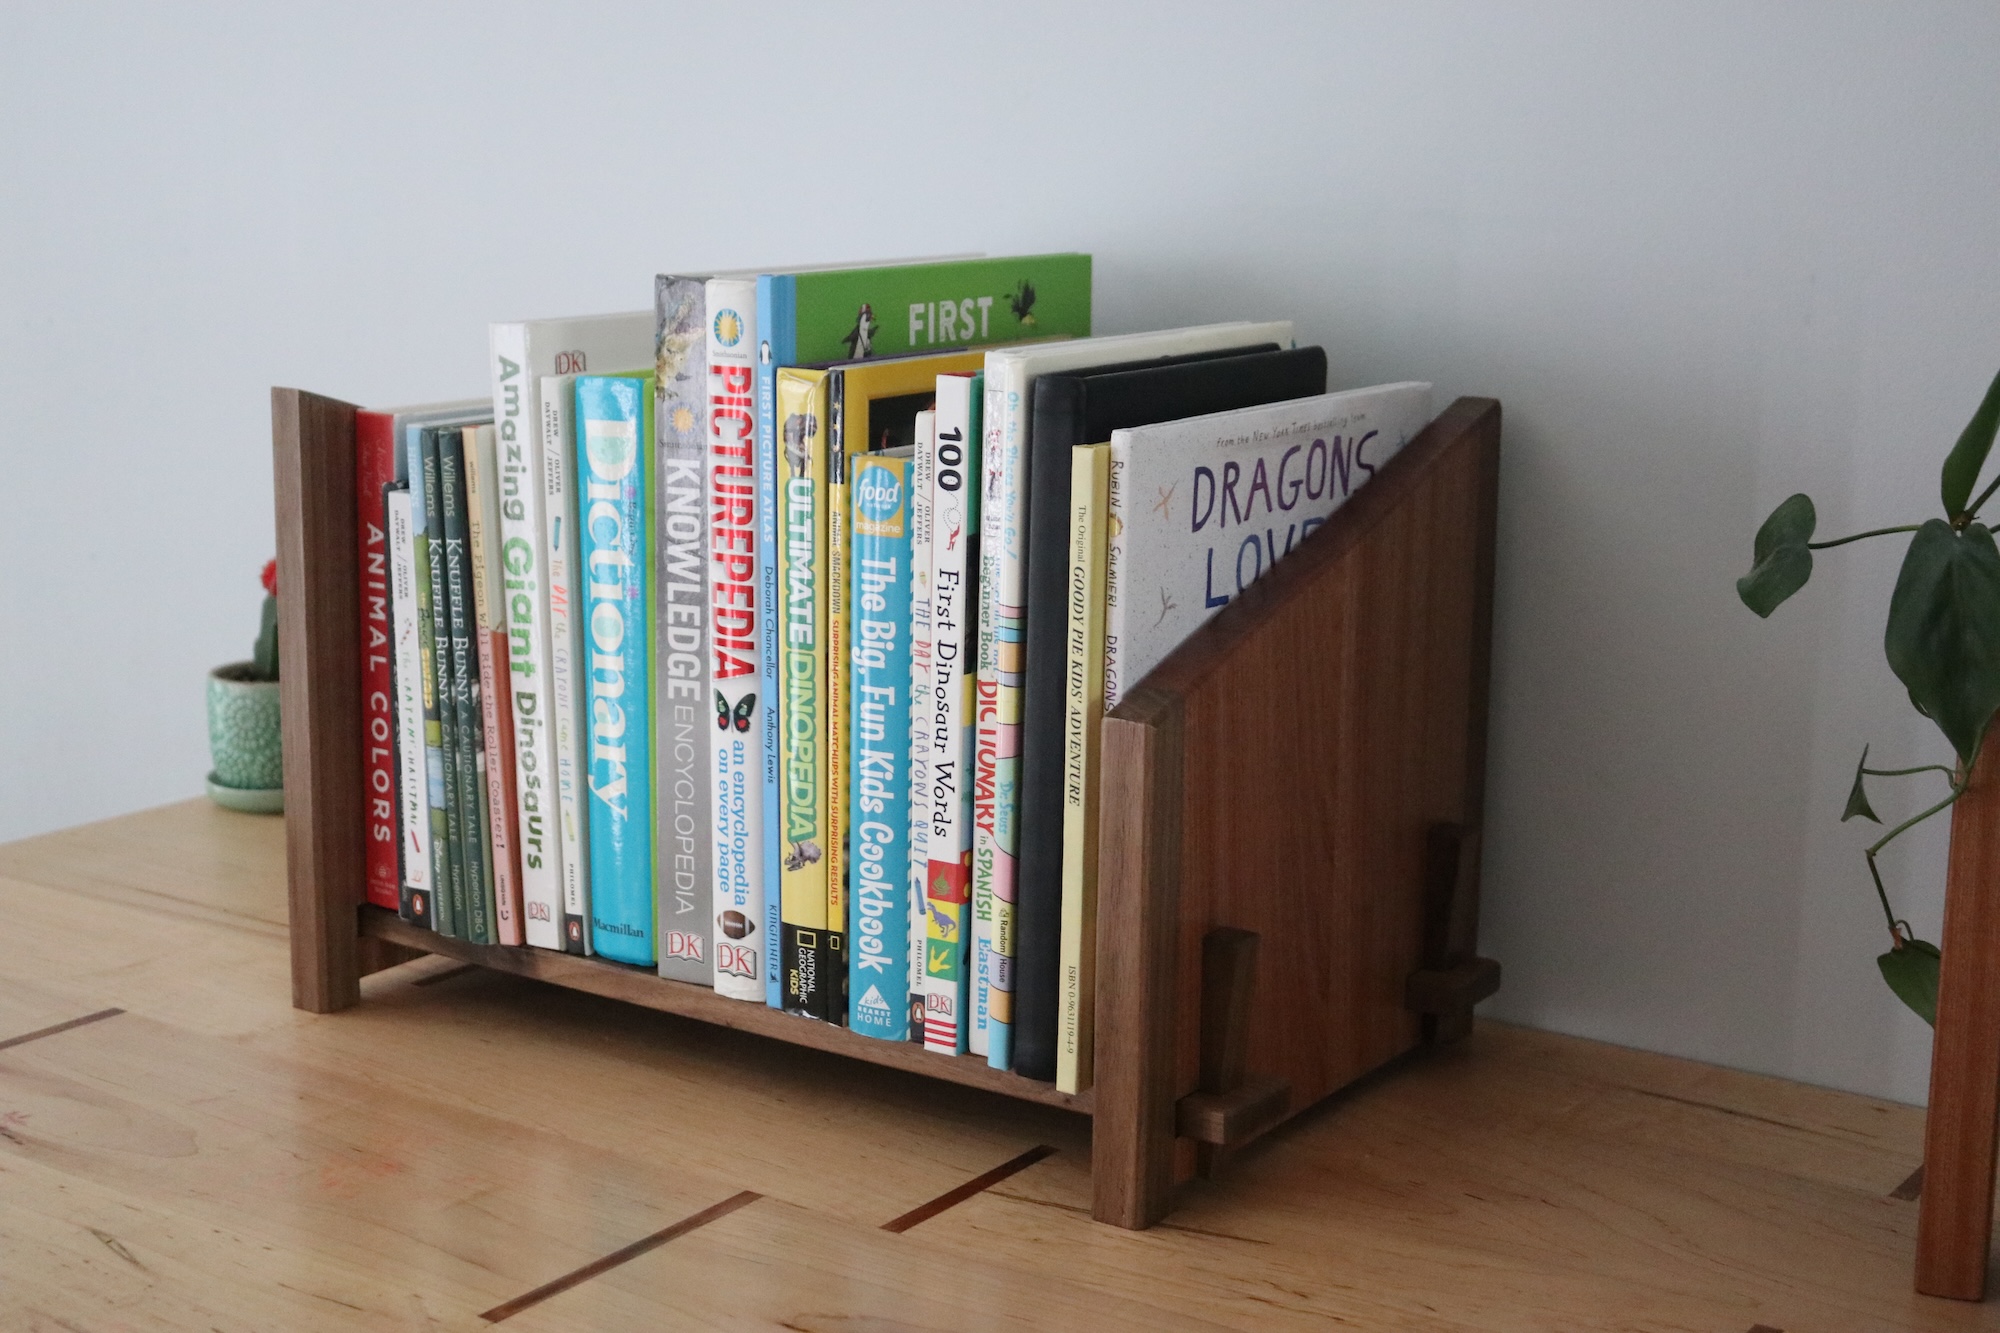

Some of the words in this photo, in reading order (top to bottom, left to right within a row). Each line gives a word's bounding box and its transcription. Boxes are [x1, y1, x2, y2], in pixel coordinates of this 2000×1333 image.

[909, 296, 993, 346] FIRST
[557, 352, 582, 375] DK
[712, 350, 748, 359] Smithsonian
[762, 376, 771, 420] FIRST
[498, 355, 527, 521] Amazing
[1007, 421, 1018, 442] the
[1216, 436, 1235, 448] from
[1236, 434, 1249, 445] the
[1312, 416, 1348, 431] bestselling
[762, 425, 772, 491] PICTURE
[937, 426, 963, 492] 100
[1005, 445, 1019, 486] Places
[1191, 429, 1379, 533] DRAGONS
[424, 456, 436, 517] Willems
[443, 455, 456, 517] Willems
[858, 477, 901, 508] food
[1004, 490, 1018, 522] You'll
[1110, 460, 1124, 508] RUBIN
[472, 521, 480, 548] The
[710, 364, 755, 682] PICTUREPEDIA
[763, 496, 773, 543] ATLAS
[856, 521, 901, 533] magazine
[1078, 505, 1087, 523] The
[788, 478, 813, 645] ULTIMATE
[1004, 527, 1018, 560] Go!
[1076, 524, 1086, 563] Original
[1205, 516, 1326, 609] LOV
[367, 521, 387, 672] ANIMAL
[428, 538, 444, 628] KNUFFLE
[446, 537, 464, 628] KNUFFLE
[474, 554, 484, 606] Pigeon
[552, 584, 568, 618] DAY
[666, 458, 701, 701] KNOWLEDGE
[764, 566, 774, 615] Deborah
[832, 550, 841, 614] SMACKDOWN
[861, 556, 897, 613] The
[937, 568, 960, 631] First
[979, 555, 994, 628] Beginner
[1073, 566, 1085, 627] GOODY
[503, 536, 536, 678] Giant
[585, 418, 637, 822] Dictionary
[915, 598, 931, 631] THE
[765, 618, 776, 680] Chancellor
[832, 620, 840, 681] SURPRISING
[851, 619, 897, 675] Big,
[914, 640, 932, 674] DAY
[980, 631, 993, 670] Book
[1072, 628, 1084, 657] PIE
[435, 636, 449, 704] BUNNY
[452, 636, 469, 705] BUNNY
[482, 652, 491, 687] Ride
[1070, 659, 1083, 704] KIDS'
[1104, 635, 1117, 712] DRAGONS
[441, 709, 449, 718] A
[460, 711, 469, 720] A
[485, 694, 493, 719] the
[860, 684, 895, 741] Fun
[914, 684, 931, 705] the
[934, 639, 957, 754] Dinosaur
[487, 725, 498, 773] Roller
[732, 740, 745, 766] an
[765, 706, 776, 752] Anthony
[789, 652, 814, 837] DINOPEDIA
[831, 721, 839, 776] MATCHUPS
[370, 691, 391, 842] COLORS
[442, 724, 457, 808] CAUTIONARY
[461, 725, 476, 808] CAUTIONARY
[516, 691, 543, 870] Dinosaurs
[719, 748, 729, 774] on
[767, 753, 776, 784] Lewis
[914, 716, 930, 809] CRAYONS
[975, 679, 998, 837] DICTIONARY
[1069, 705, 1082, 807] ADVENTURE
[831, 777, 839, 804] WITH
[858, 748, 895, 814] Kids
[933, 760, 955, 838] Words
[448, 814, 457, 842] TALE
[467, 814, 477, 843] TALE
[491, 780, 505, 849] Coaster!
[674, 705, 695, 915] ENCYCLOPEDIA
[717, 778, 729, 838] every
[998, 801, 1015, 835] Seuss
[729, 770, 749, 906] encyclopedia
[830, 805, 839, 867] SURPRISING
[913, 820, 928, 868] QUIT
[979, 835, 988, 845] in
[451, 864, 463, 910] Hyperion
[470, 861, 481, 907] Hyperion
[717, 841, 730, 892] page
[830, 867, 839, 906] RESULTS
[976, 847, 993, 922] SPANISH
[530, 902, 549, 919] DK
[858, 820, 894, 975] Cookbook
[593, 916, 644, 938] Macmillan
[669, 932, 702, 959] DK
[999, 919, 1008, 953] Random
[719, 944, 753, 975] DK
[799, 947, 808, 1004] GEOGRAPHIC
[807, 950, 815, 993] NATIONAL
[977, 935, 991, 1030] Eastman
[999, 958, 1007, 983] House
[1067, 965, 1076, 991] ISBN
[857, 1005, 891, 1017] HEARST
[857, 1012, 892, 1027] HOME
[864, 995, 884, 1005] kids
[929, 993, 950, 1012] DK
[1066, 991, 1076, 1054] 0-9631119-4-9
